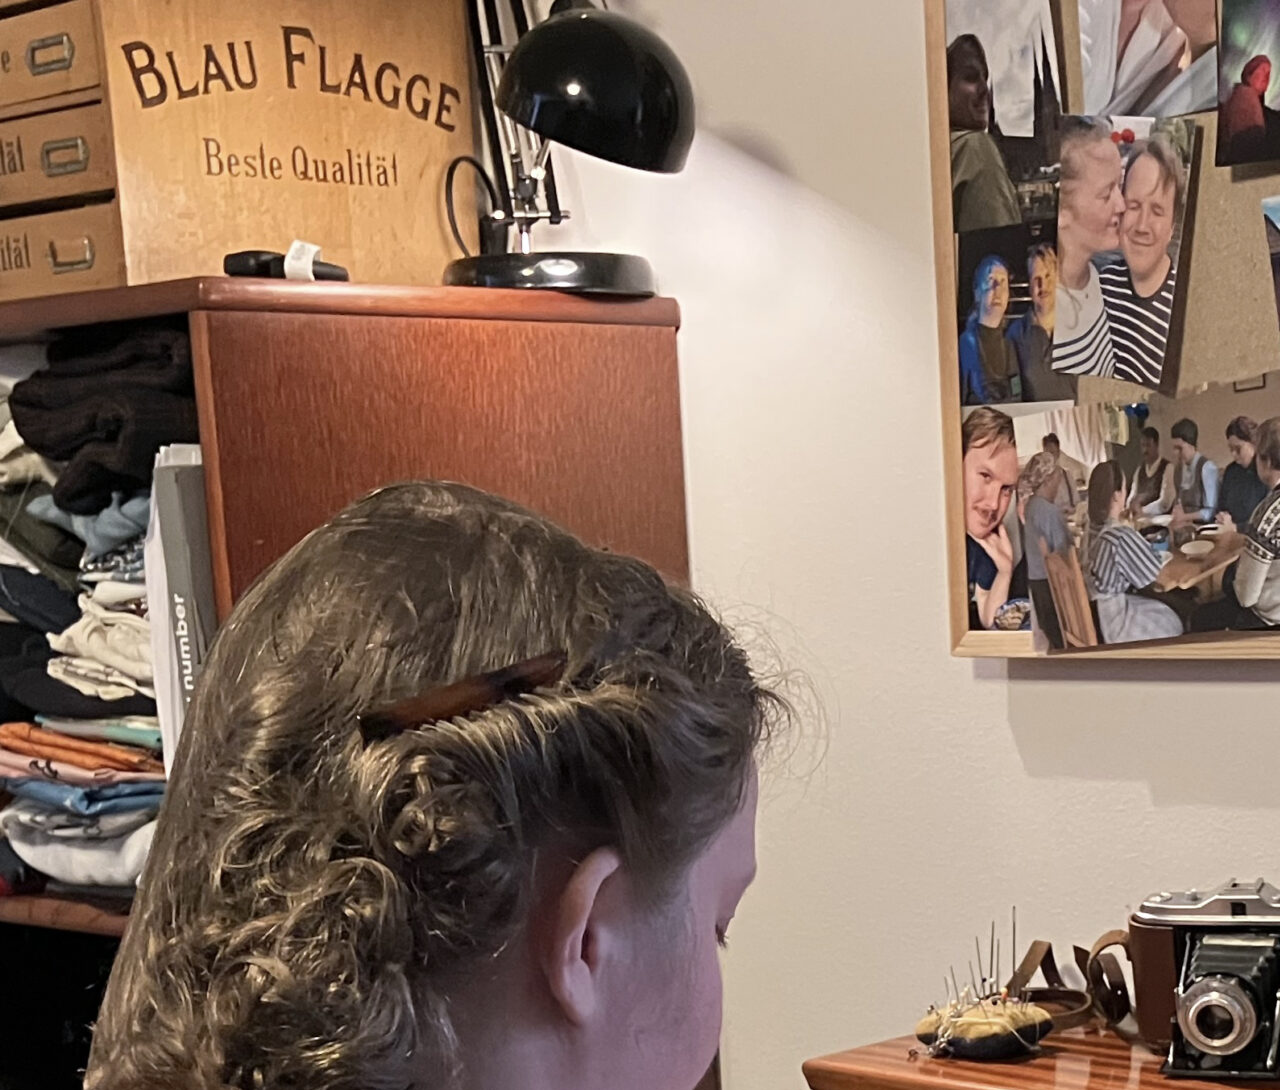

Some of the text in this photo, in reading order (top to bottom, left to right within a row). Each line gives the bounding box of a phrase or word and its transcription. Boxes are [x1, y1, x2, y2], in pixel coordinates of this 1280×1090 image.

[121, 26, 461, 132] BLAU FLAGGE
[203, 137, 398, 187] Beste Qualität
[174, 593, 194, 690] number
